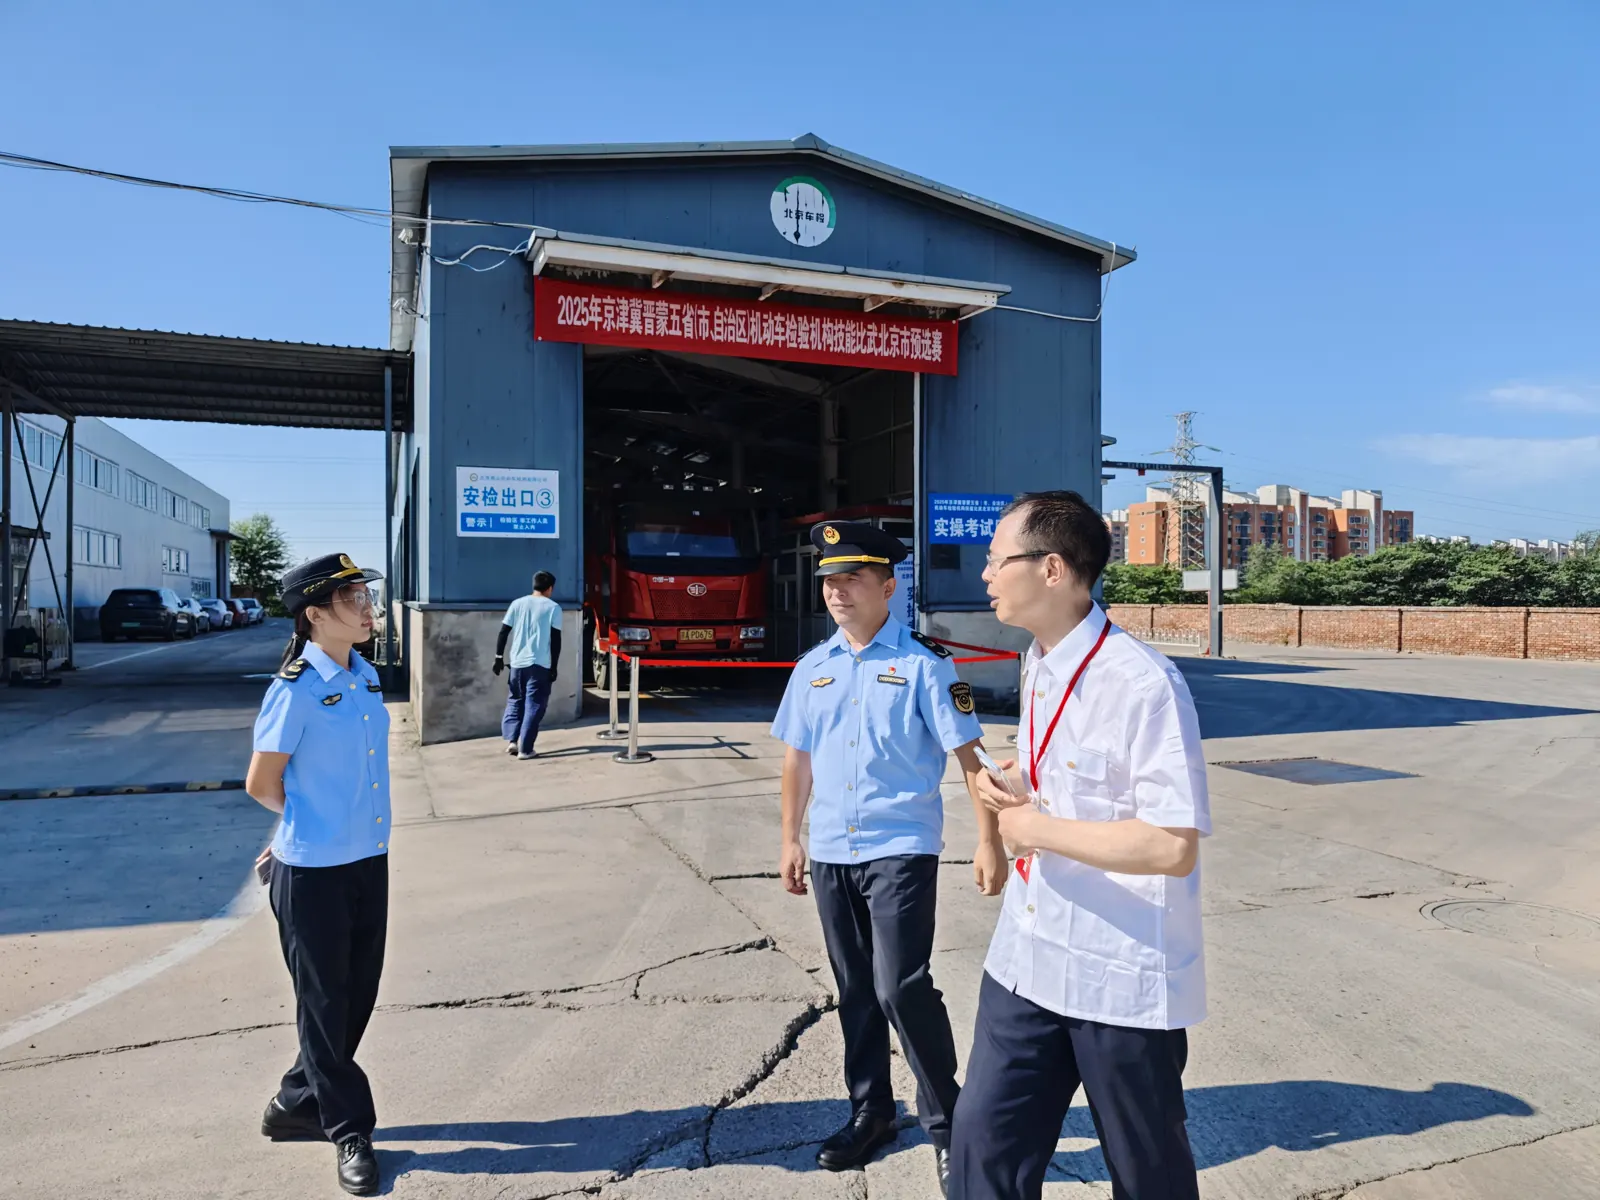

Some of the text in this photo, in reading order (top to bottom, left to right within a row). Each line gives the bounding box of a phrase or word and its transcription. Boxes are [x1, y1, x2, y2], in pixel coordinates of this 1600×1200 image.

[465, 517, 487, 528] 警示
[934, 517, 1000, 538] 实操考试
